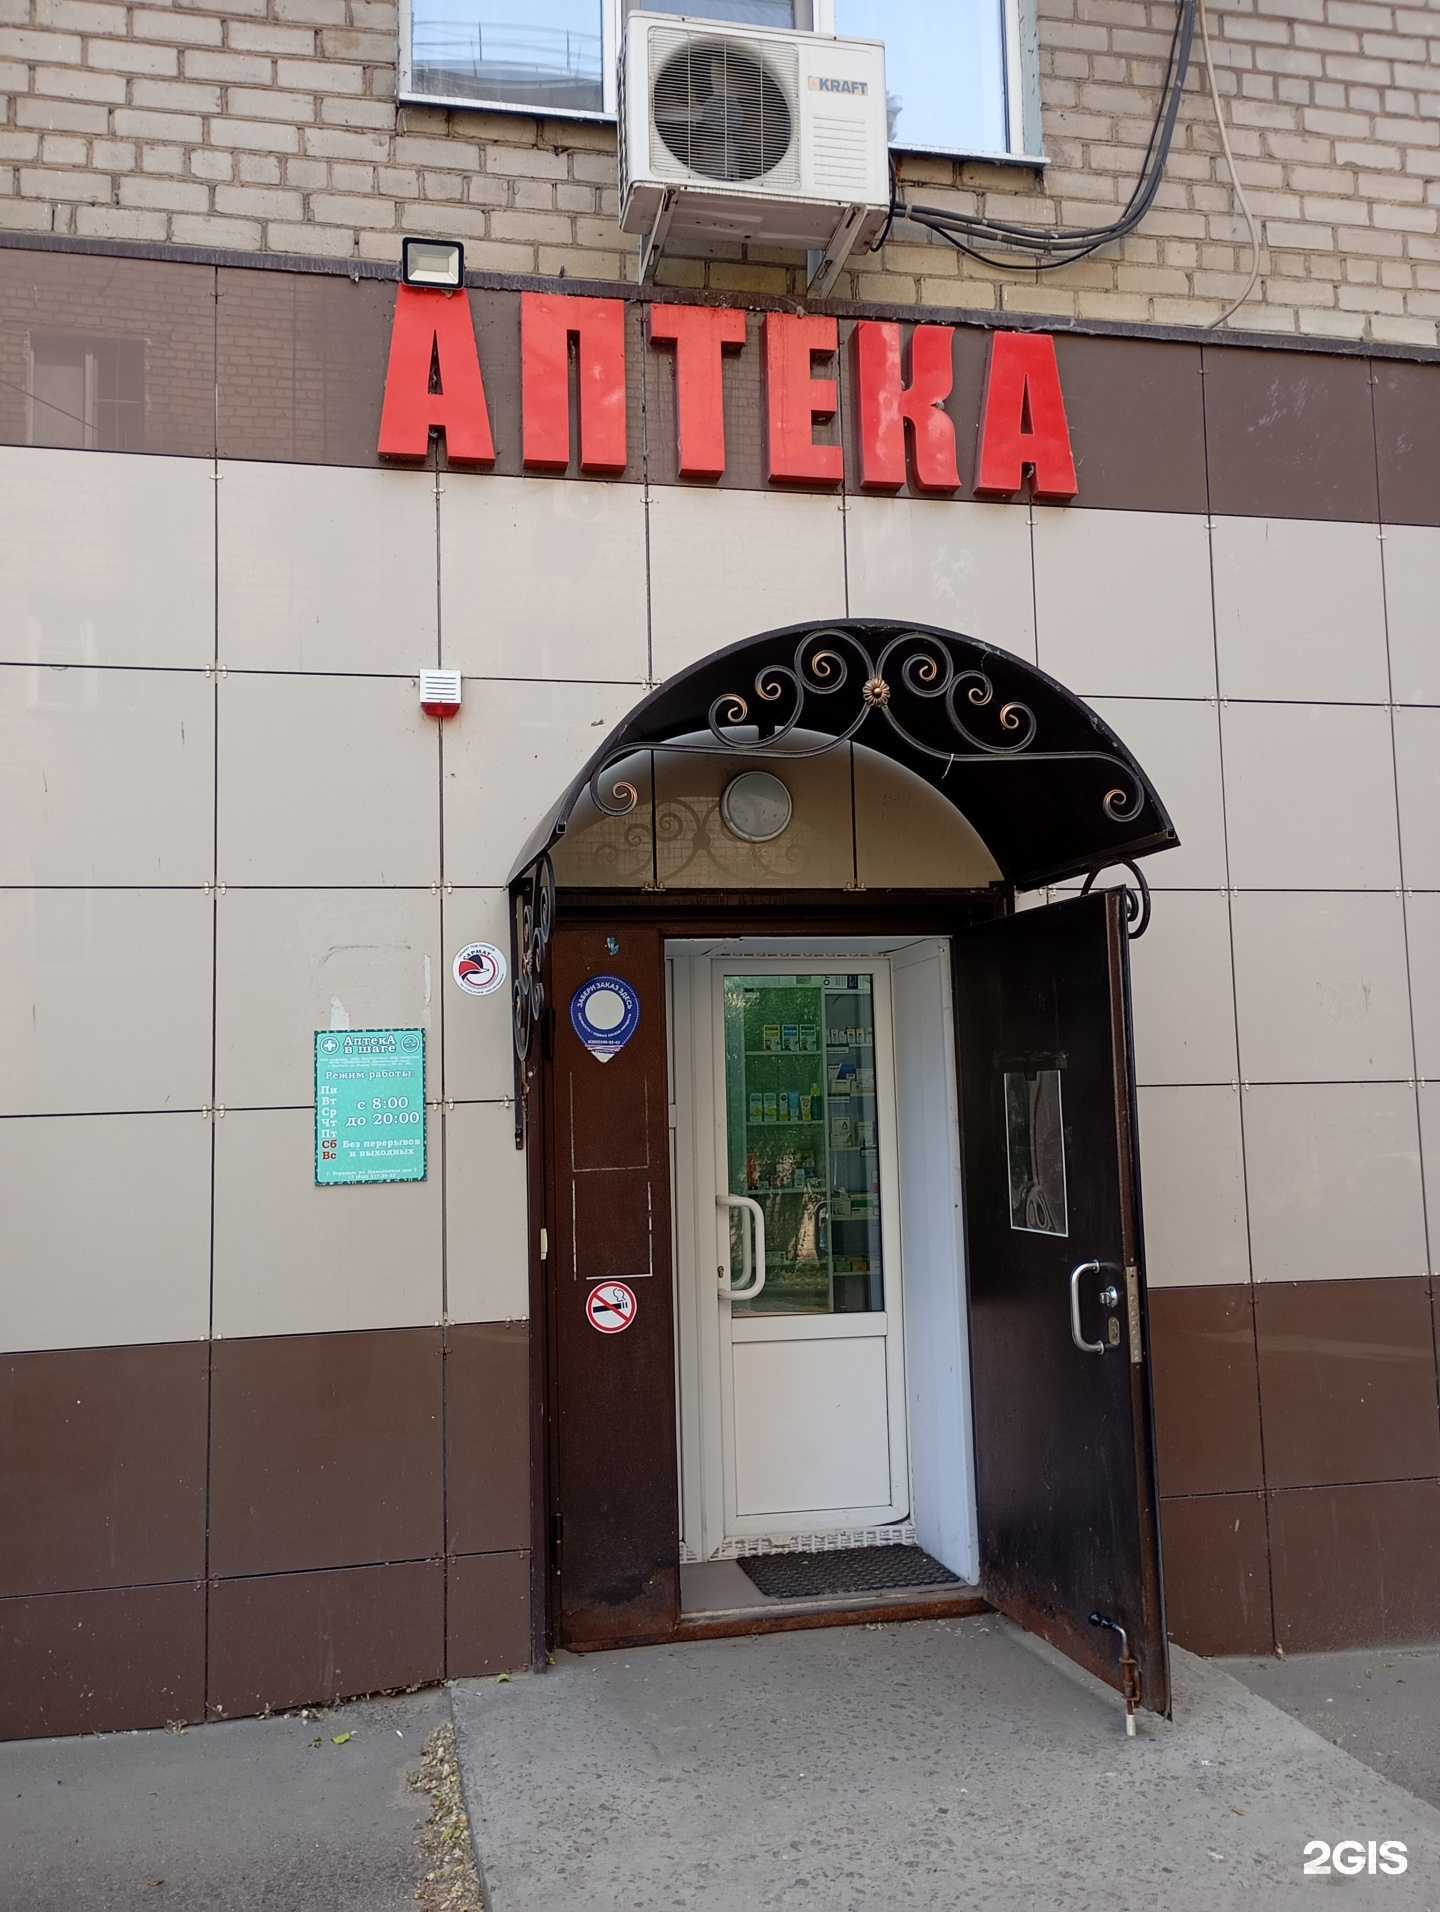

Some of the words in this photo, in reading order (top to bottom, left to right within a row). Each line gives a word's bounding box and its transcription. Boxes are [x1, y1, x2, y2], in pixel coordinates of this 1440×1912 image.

[820, 78, 868, 96] KRAFT
[377, 287, 1079, 499] АПТЕКА
[577, 984, 597, 1008] ЗАБЕРИ
[596, 981, 619, 991] ЗАКАЗ
[618, 988, 633, 1009] ЗДЕСЬ
[344, 1046, 353, 1054] в
[358, 1045, 396, 1054] шаге
[326, 1071, 364, 1080] Режим
[321, 1086, 337, 1095] Пн
[322, 1096, 337, 1105] Вт
[357, 1101, 366, 1110] с
[372, 1096, 409, 1109] 8:00
[321, 1108, 337, 1118] Ср
[321, 1118, 337, 1127] Чт
[345, 1116, 367, 1127] до
[373, 1111, 420, 1125] 20:00
[321, 1129, 337, 1138] Пт
[322, 1139, 337, 1149] Сб
[343, 1140, 361, 1149] Без
[364, 1138, 420, 1149] перерывов
[322, 1151, 337, 1160] Вс
[360, 1148, 415, 1158] выходных
